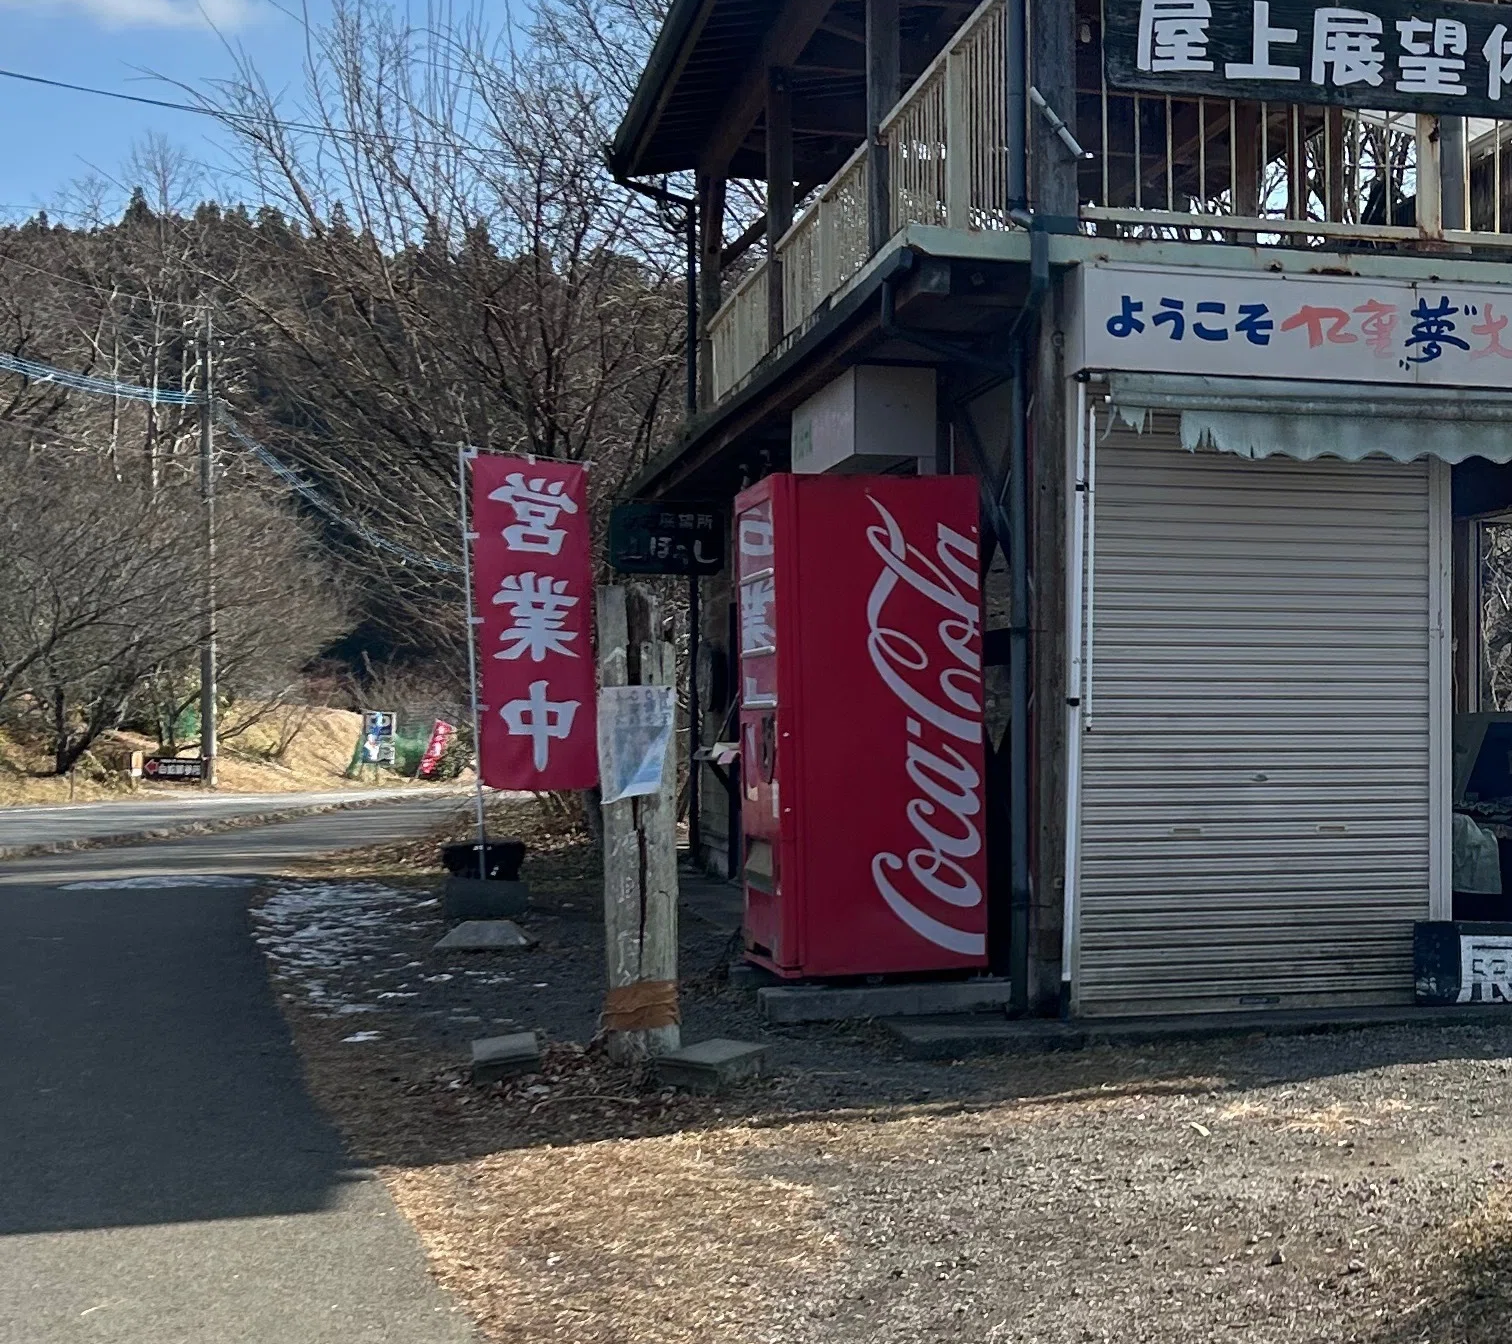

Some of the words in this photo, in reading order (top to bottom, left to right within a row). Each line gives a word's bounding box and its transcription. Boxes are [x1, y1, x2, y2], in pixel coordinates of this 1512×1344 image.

[488, 472, 581, 773] 営業中
[866, 494, 986, 956] Coca-Cola
